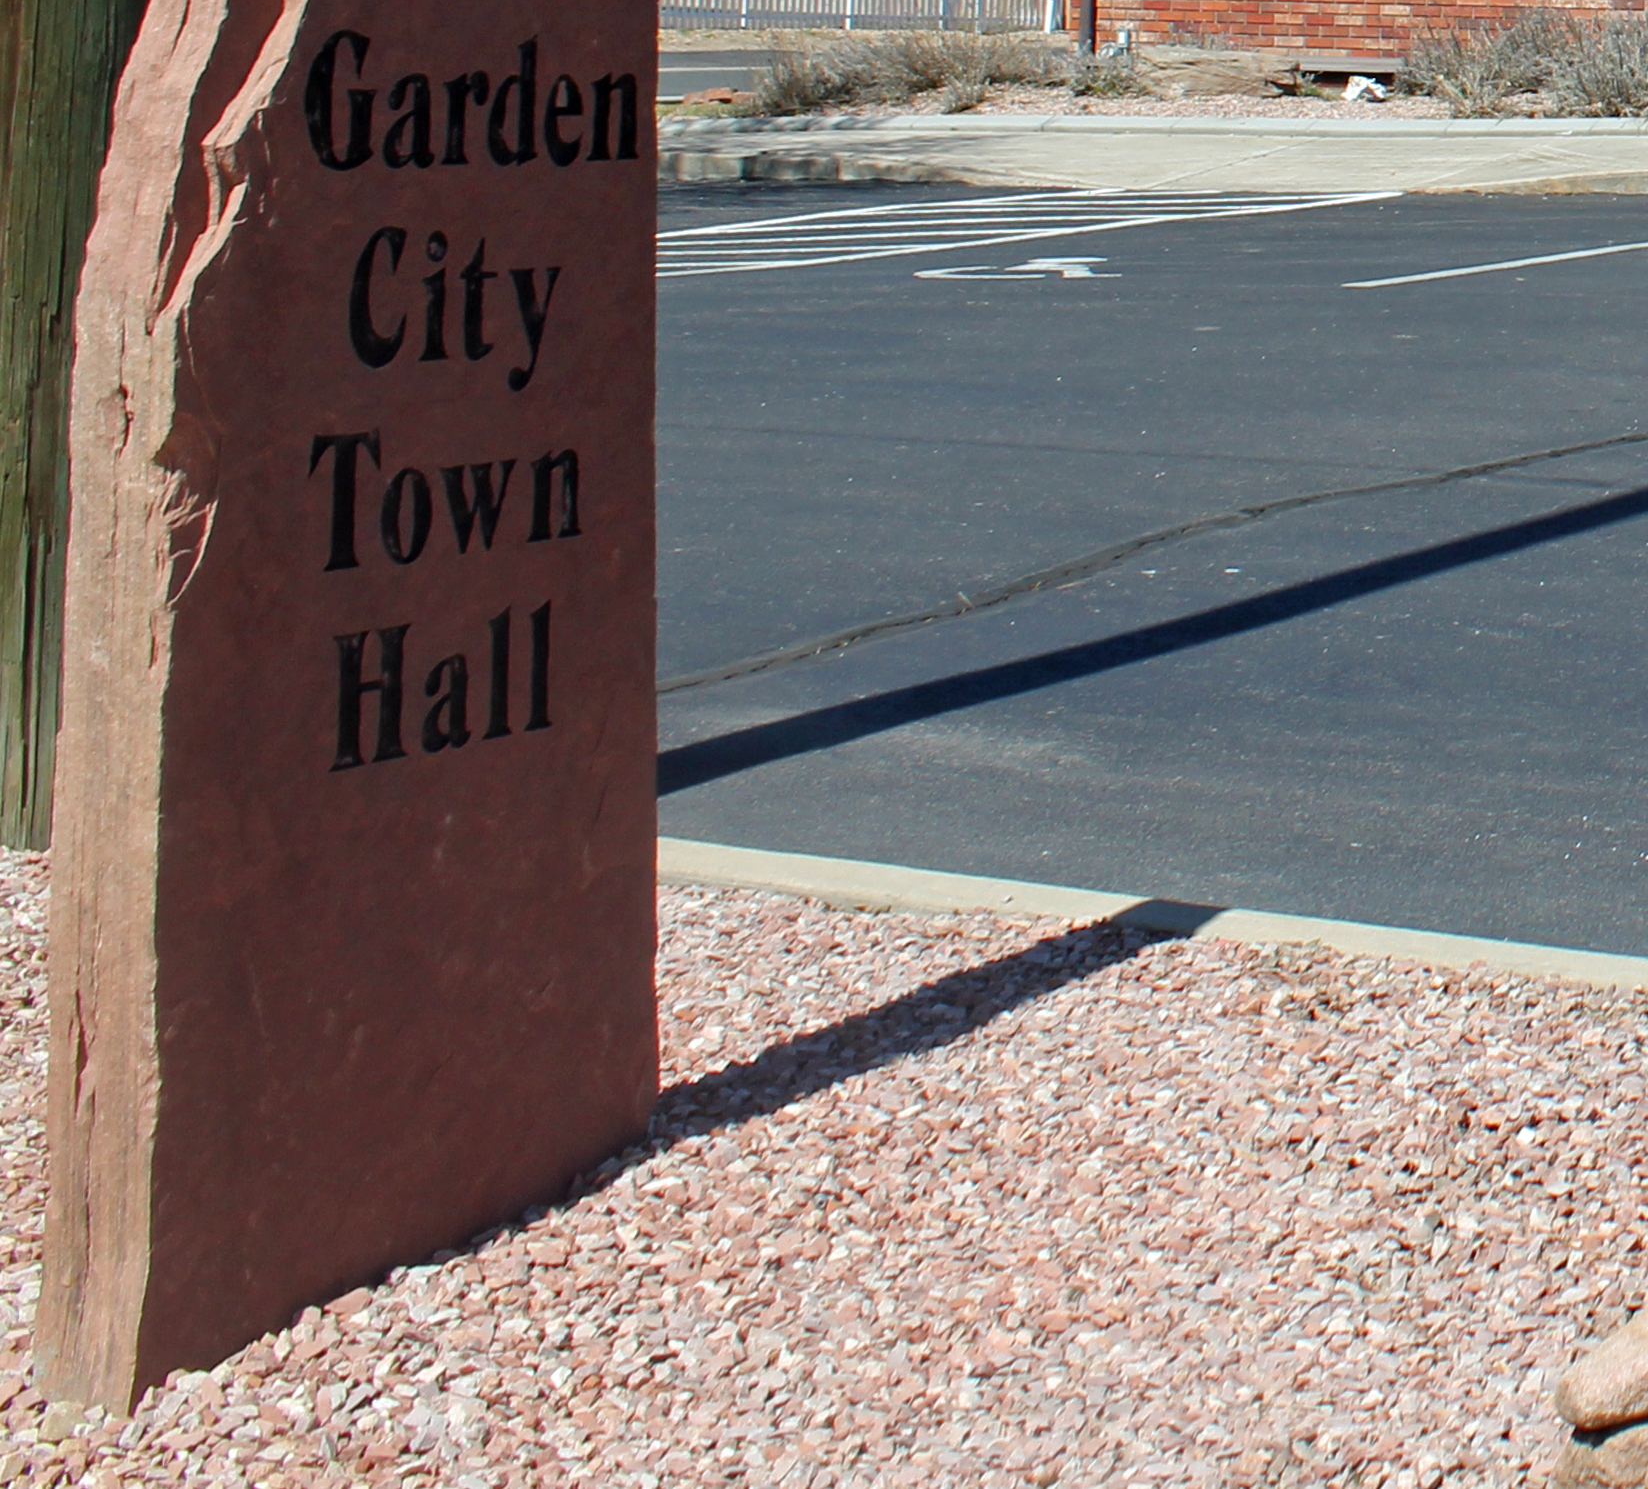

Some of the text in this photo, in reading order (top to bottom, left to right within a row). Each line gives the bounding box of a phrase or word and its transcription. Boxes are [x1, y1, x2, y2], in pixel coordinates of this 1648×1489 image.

[304, 28, 639, 173] Garden
[348, 225, 561, 393] City
[306, 428, 582, 573] Town
[327, 599, 553, 775] Hall
